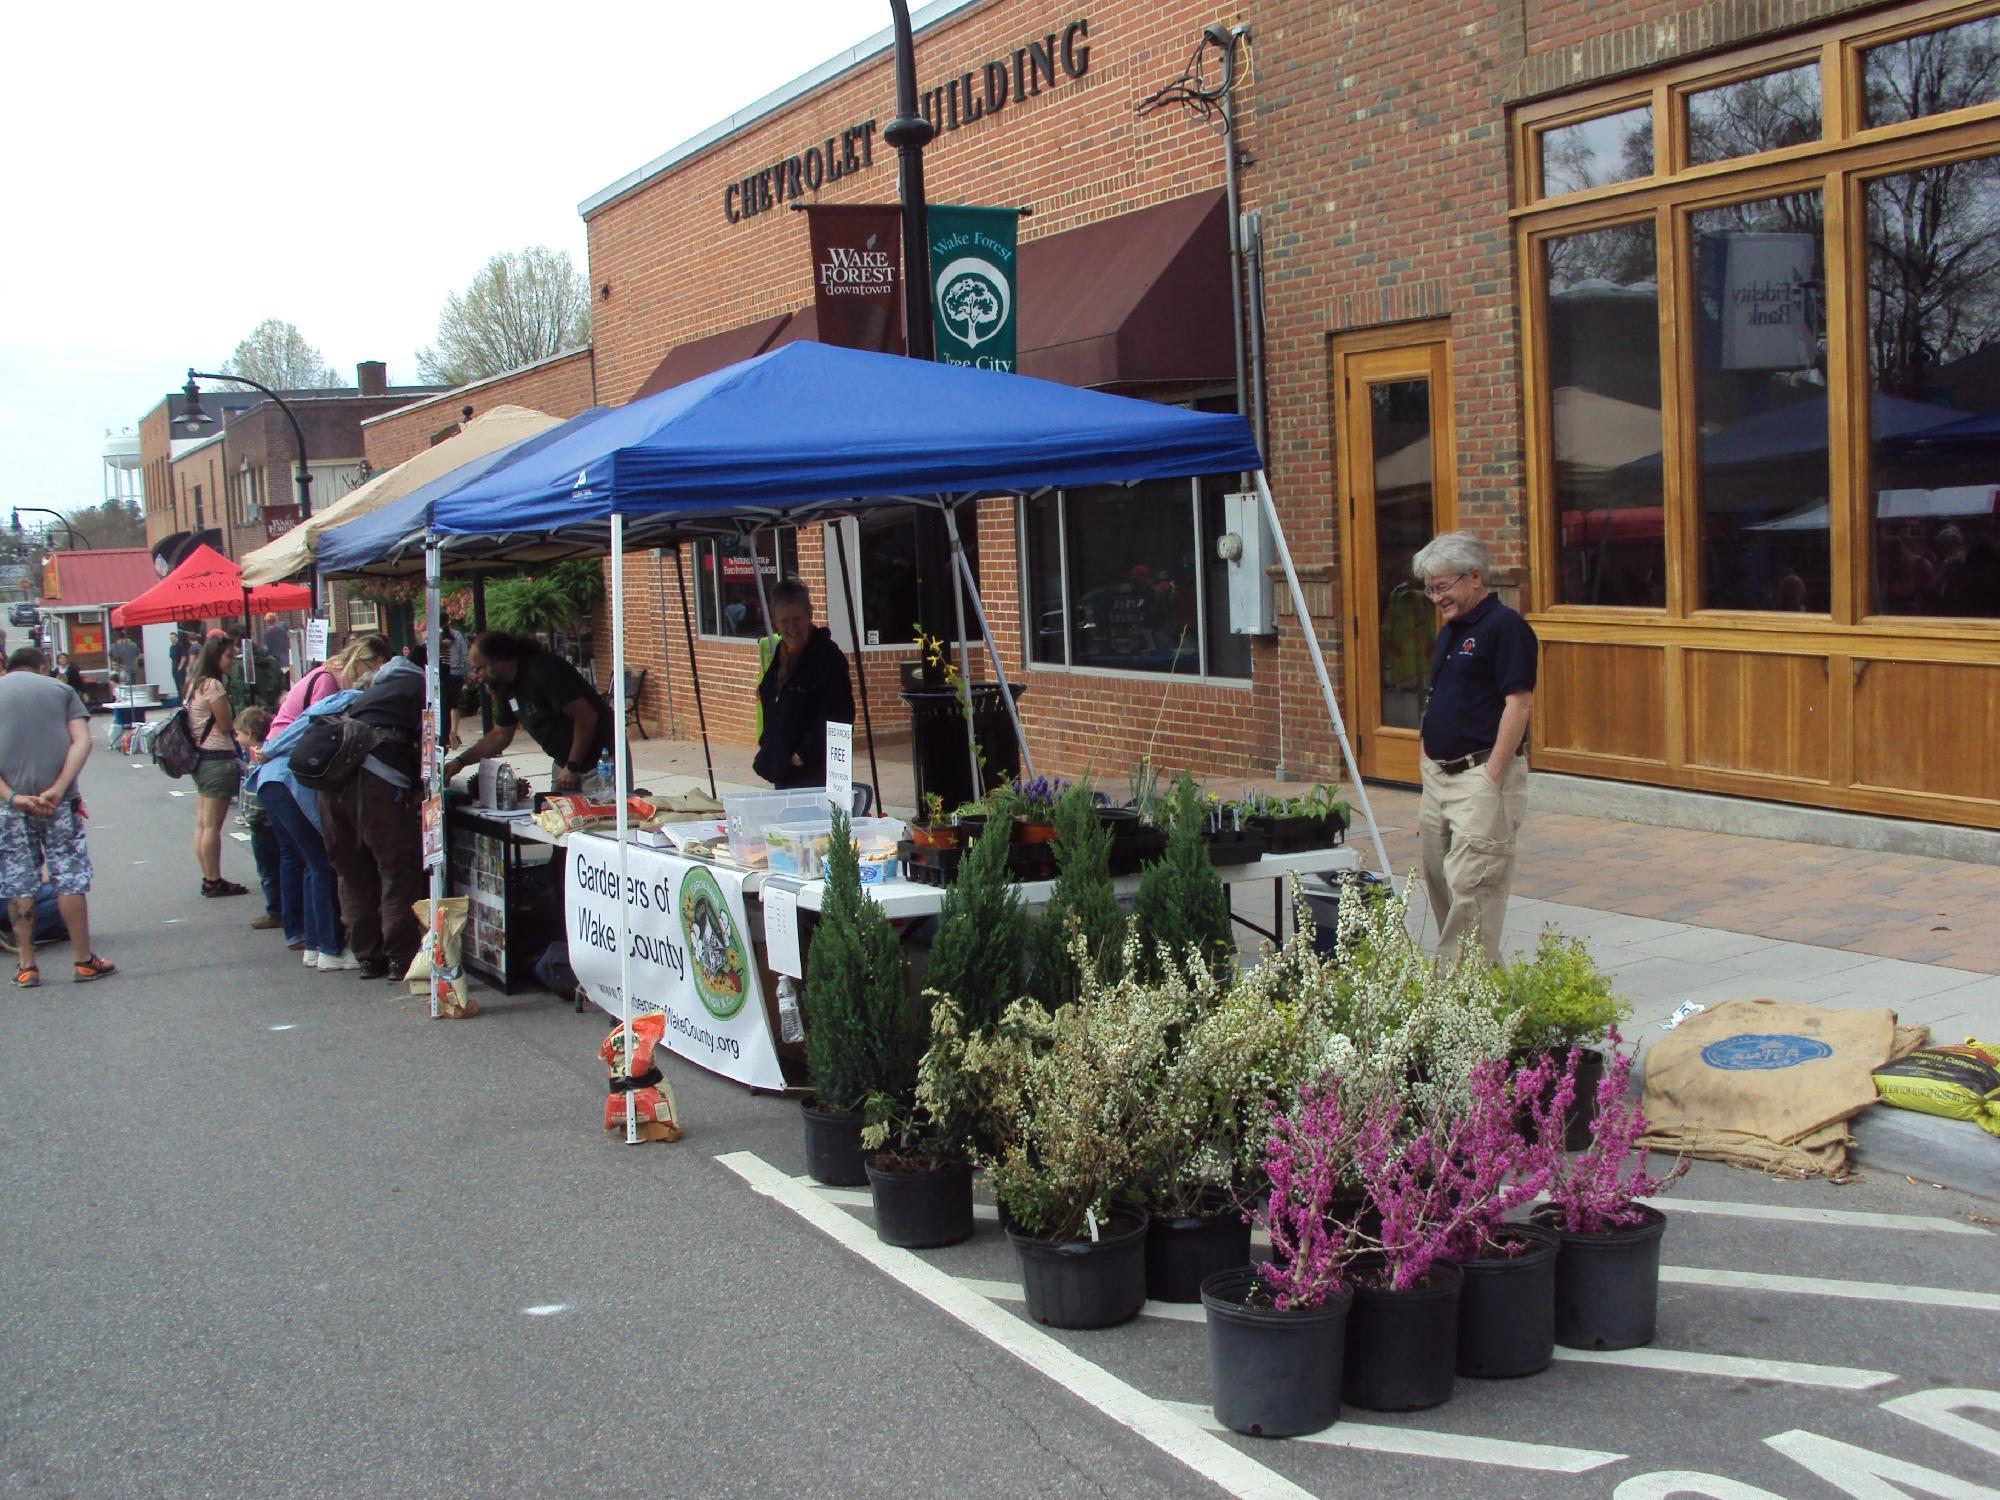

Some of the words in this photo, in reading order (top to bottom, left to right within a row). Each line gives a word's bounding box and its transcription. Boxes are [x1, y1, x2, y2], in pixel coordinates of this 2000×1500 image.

[724, 119, 877, 224] CHEVROLET
[919, 18, 1091, 139] UILDING
[932, 232, 970, 256] Wake
[974, 231, 1013, 262] Forest
[828, 247, 889, 269] WAKE
[820, 263, 896, 285] FOREST
[825, 280, 892, 296] downtown
[975, 356, 1013, 373] City
[831, 746, 846, 763] FREE
[655, 877, 671, 914] of
[578, 905, 617, 953] Wake
